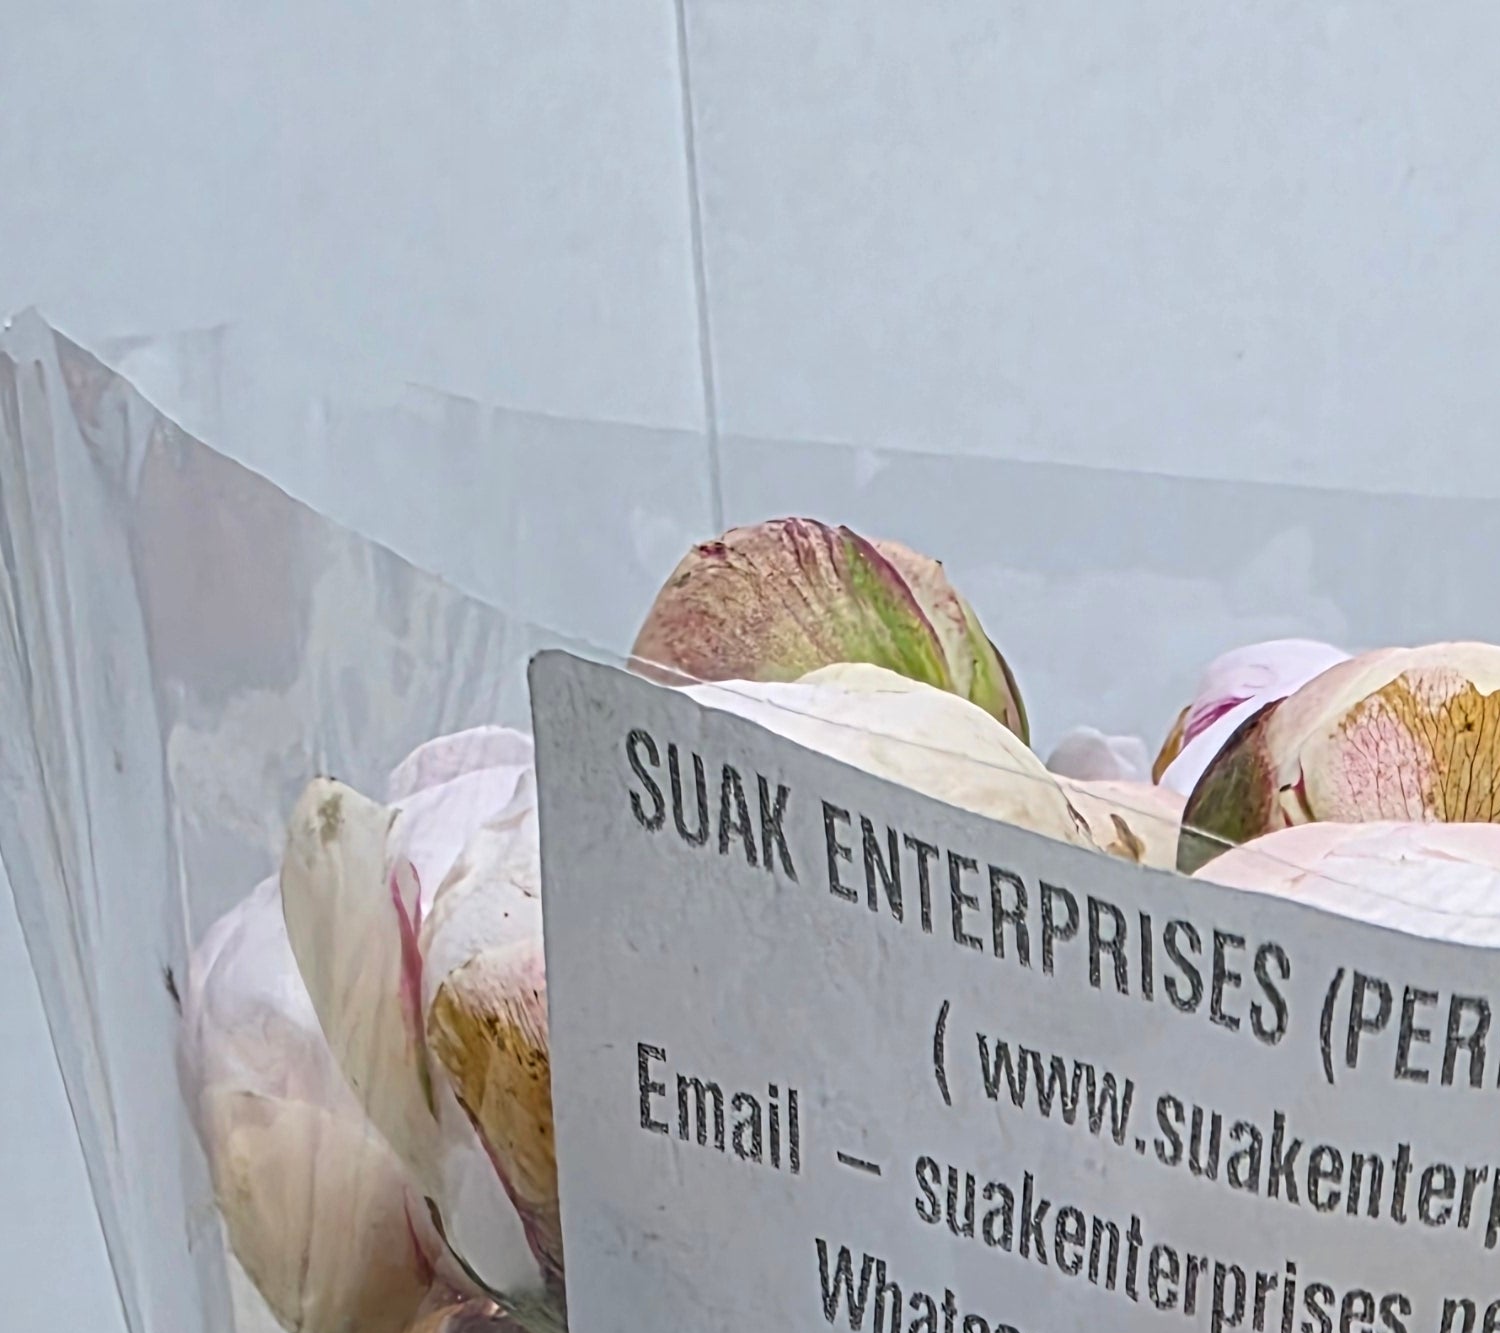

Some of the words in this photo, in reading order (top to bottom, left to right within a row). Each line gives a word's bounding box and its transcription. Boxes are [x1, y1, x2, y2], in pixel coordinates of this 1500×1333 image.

[625, 729, 799, 880] SUAK
[821, 799, 1290, 1046] ENTERPRISES
[637, 1042, 801, 1176] Email
